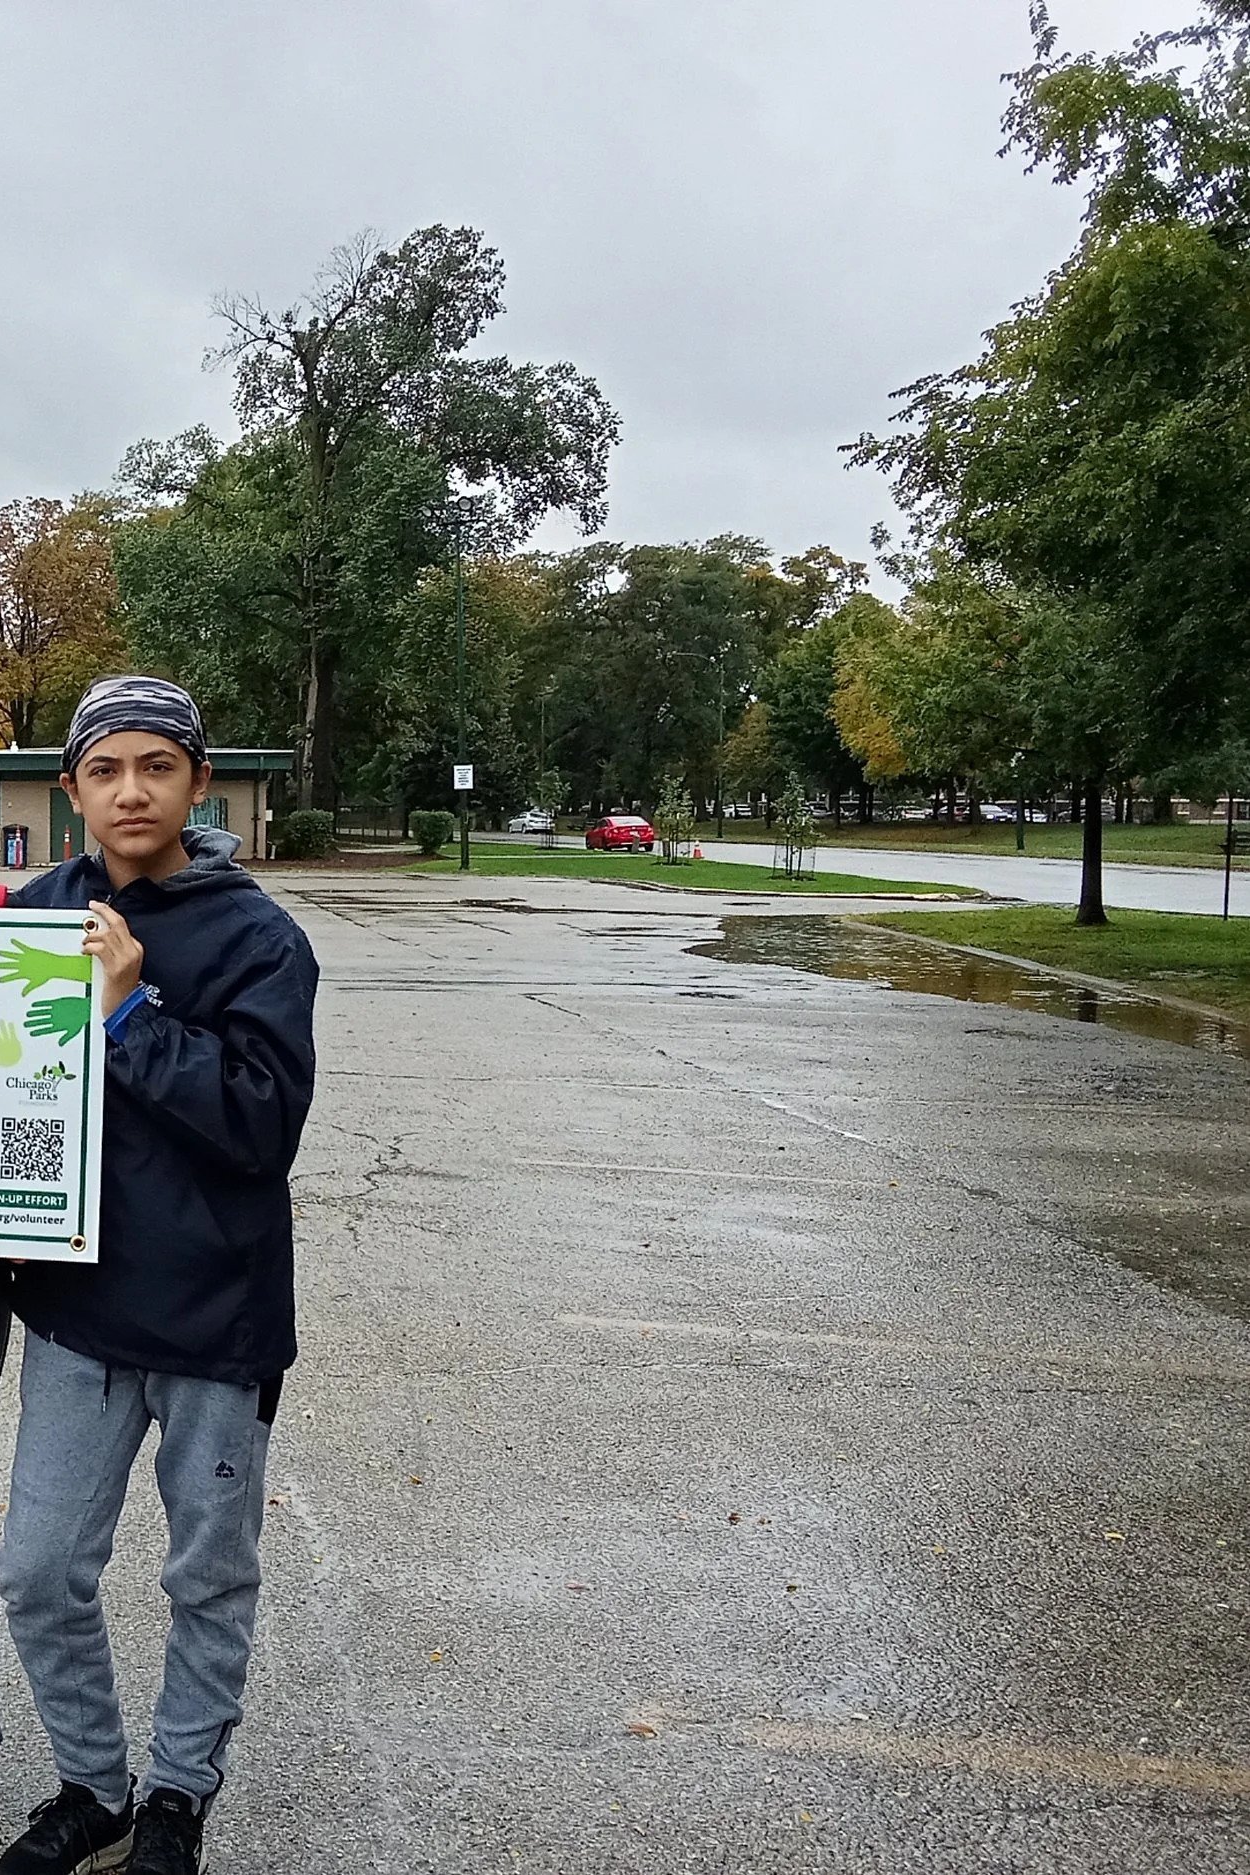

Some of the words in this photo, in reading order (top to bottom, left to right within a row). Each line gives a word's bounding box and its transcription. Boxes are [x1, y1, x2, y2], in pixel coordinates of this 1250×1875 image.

[5, 1076, 52, 1093] Chicago
[29, 1089, 59, 1101] Parks
[25, 1194, 65, 1206] EFFORT
